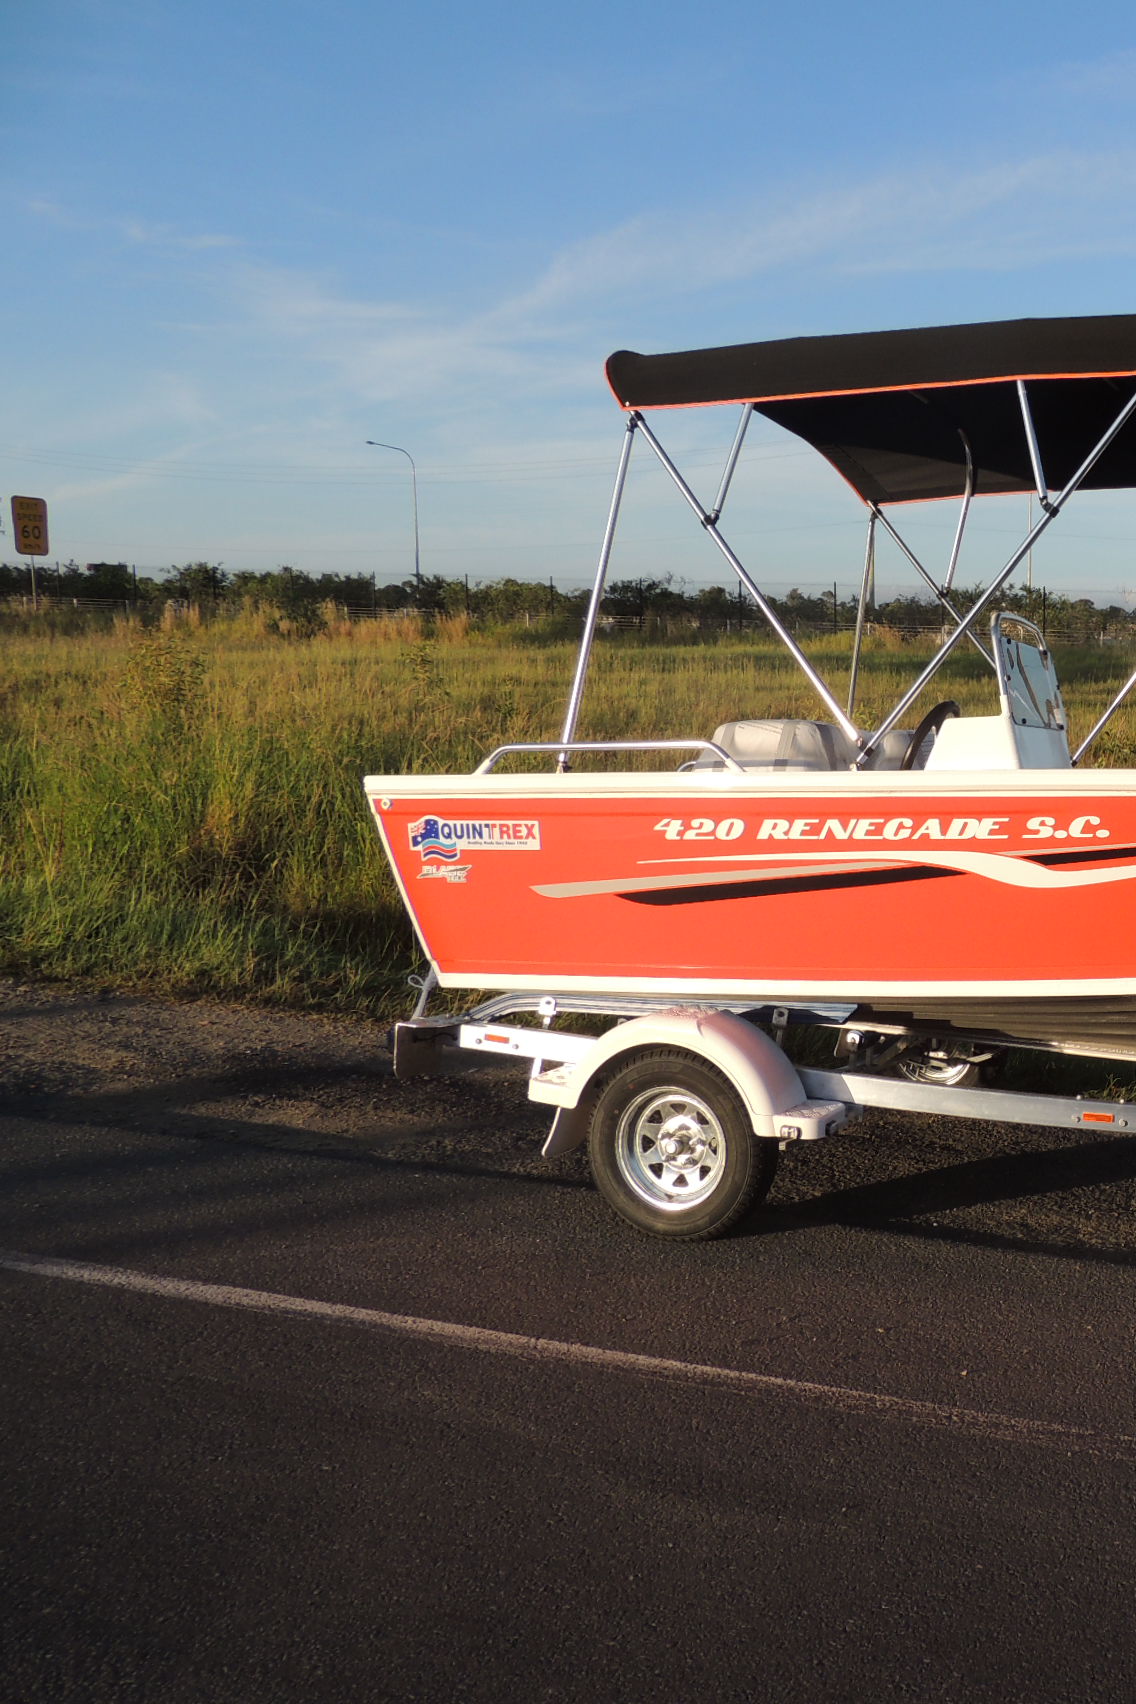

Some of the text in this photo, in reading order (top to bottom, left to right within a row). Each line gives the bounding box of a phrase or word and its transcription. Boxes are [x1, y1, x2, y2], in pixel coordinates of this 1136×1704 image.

[22, 525, 41, 540] 60
[440, 823, 537, 840] QUINTREX
[653, 815, 1111, 841] 420 RENEGADE S.C.
